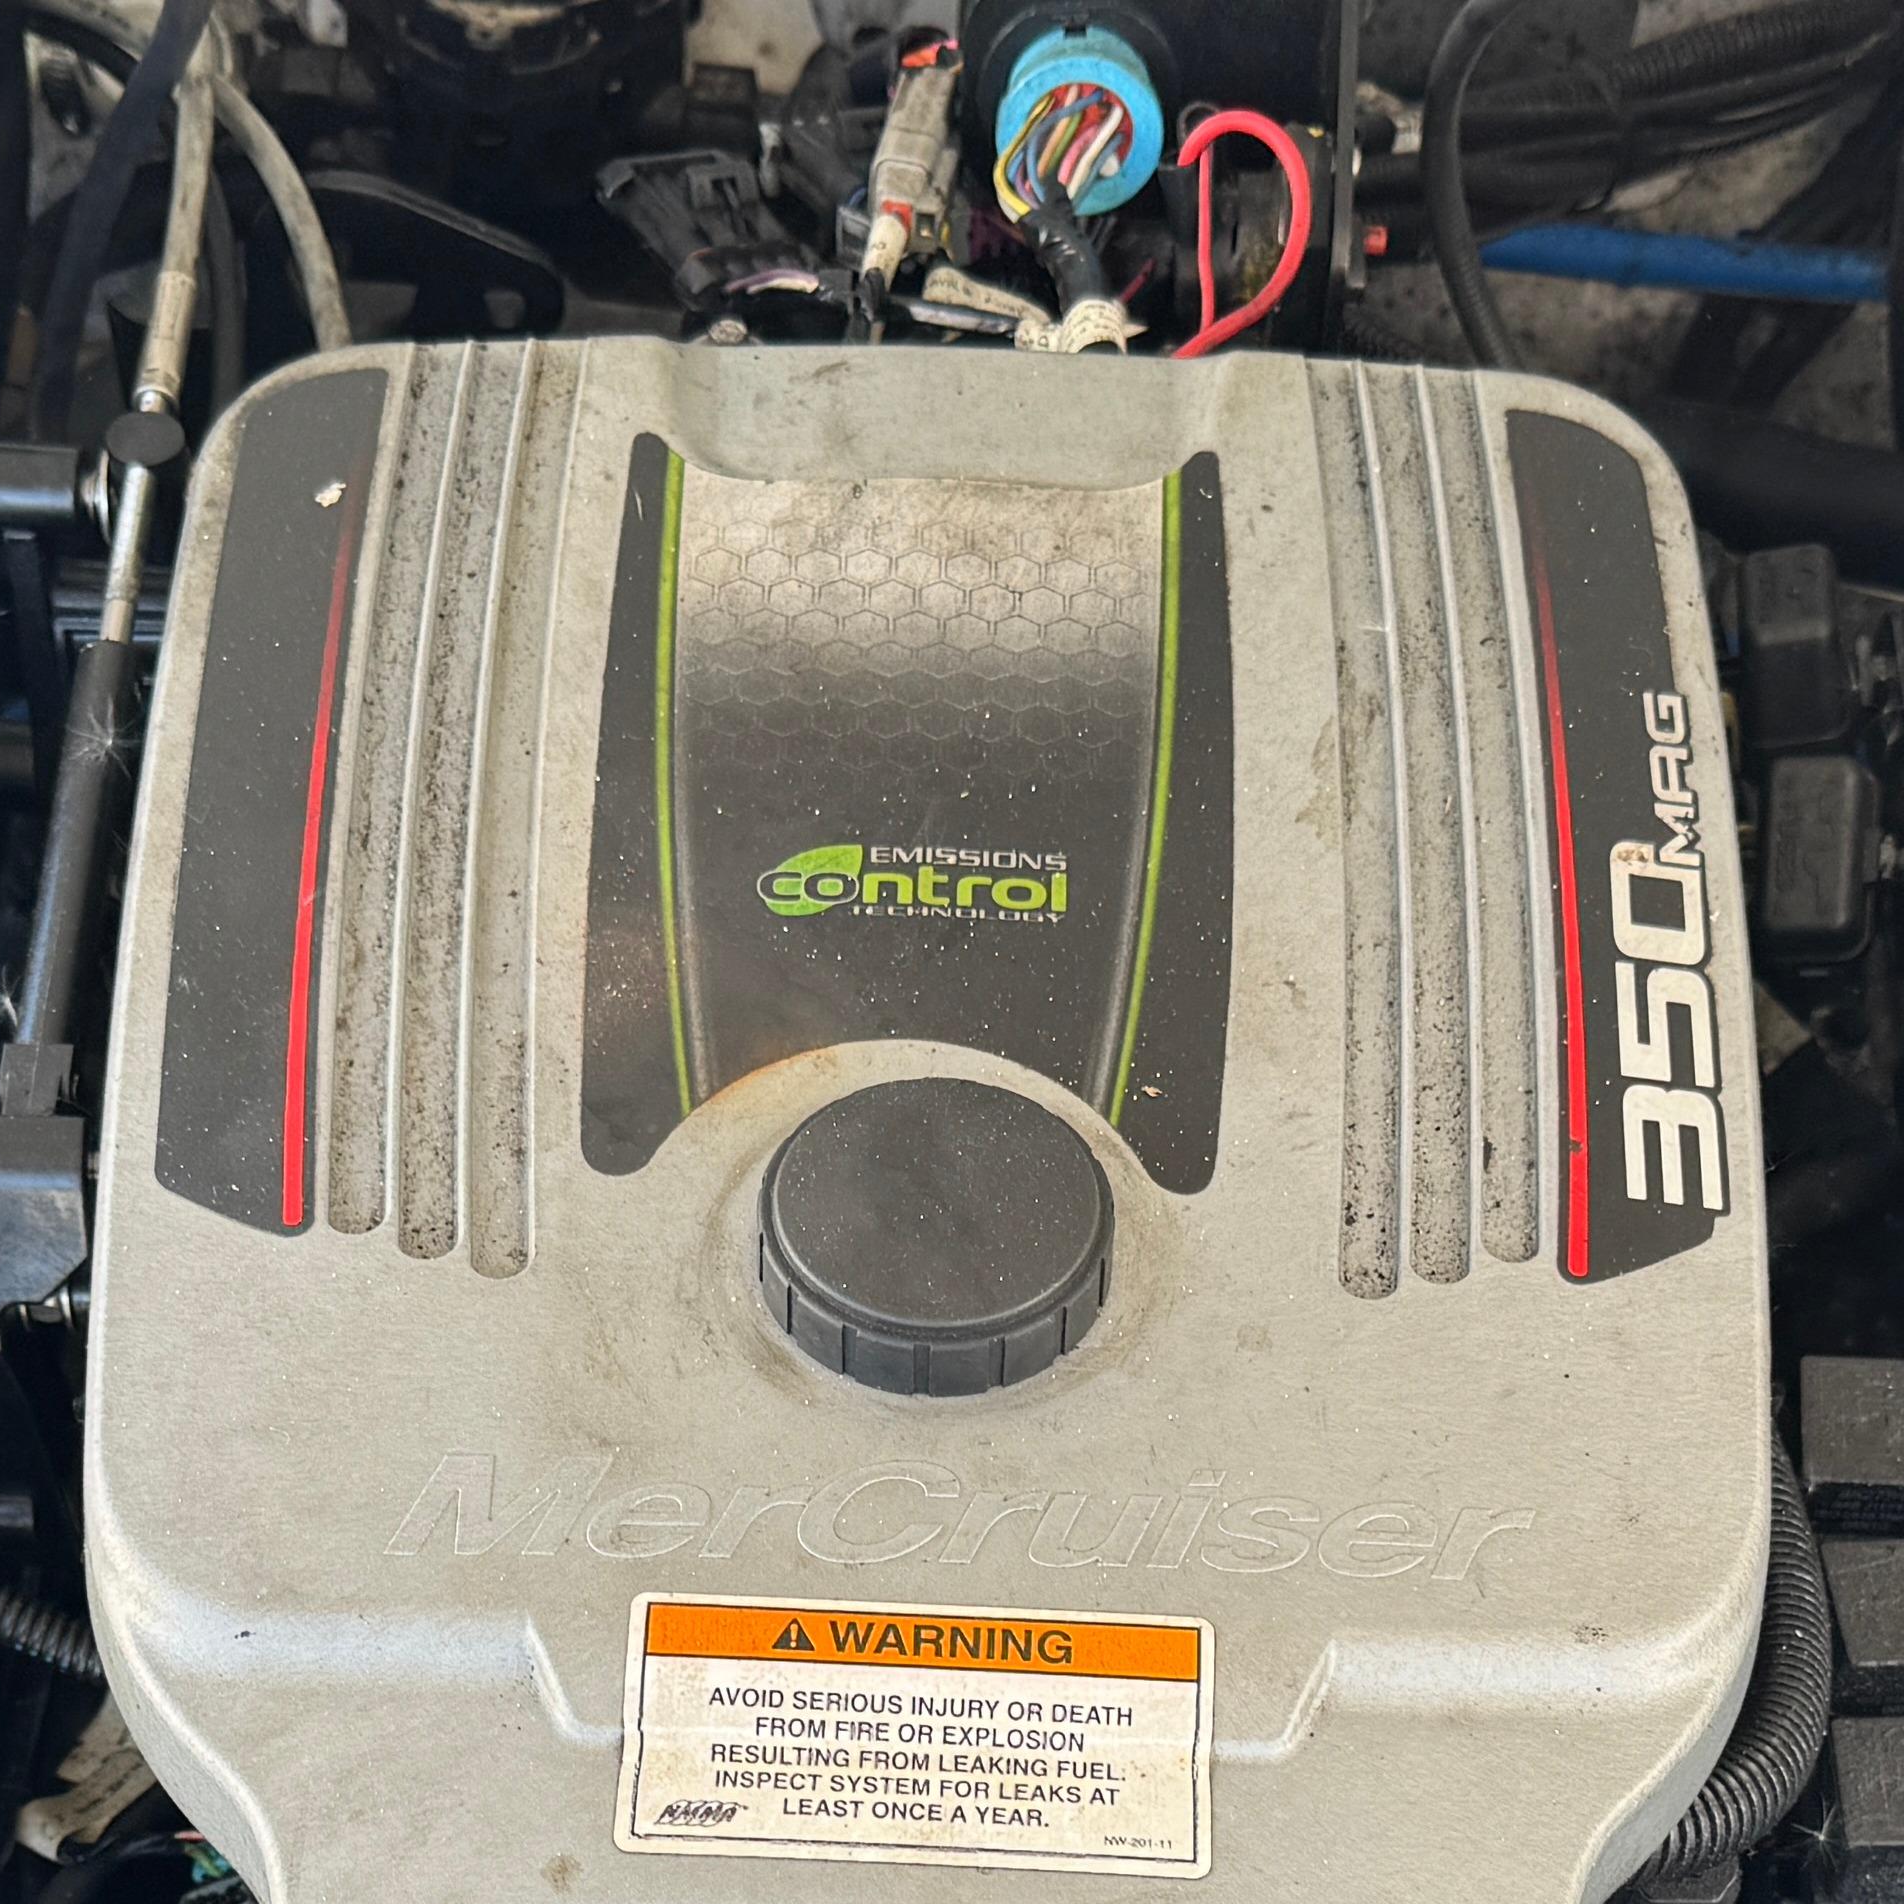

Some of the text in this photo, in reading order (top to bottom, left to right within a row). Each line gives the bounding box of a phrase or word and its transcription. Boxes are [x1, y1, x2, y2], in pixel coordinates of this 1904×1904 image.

[870, 846, 1068, 871] EMISSIONS
[757, 866, 1068, 913] control
[851, 904, 1065, 923] TECHNOLOGY
[1610, 690, 1724, 1210] 350 MAG
[383, 1449, 1539, 1583] MerCruiser
[829, 1620, 1074, 1664] WARNING
[709, 1687, 1132, 1727] AVOID SERIOUS INJURY OR DEATH
[756, 1716, 1084, 1752] FROM FIRE OR EXPLOSION
[711, 1743, 1126, 1781] RESULTING FROM LEAKING FUEL.
[715, 1770, 1120, 1806] INSPECT SYSTEM FOR LEAKS AT
[783, 1797, 1049, 1828] LEAST ONCE A YEAR.
